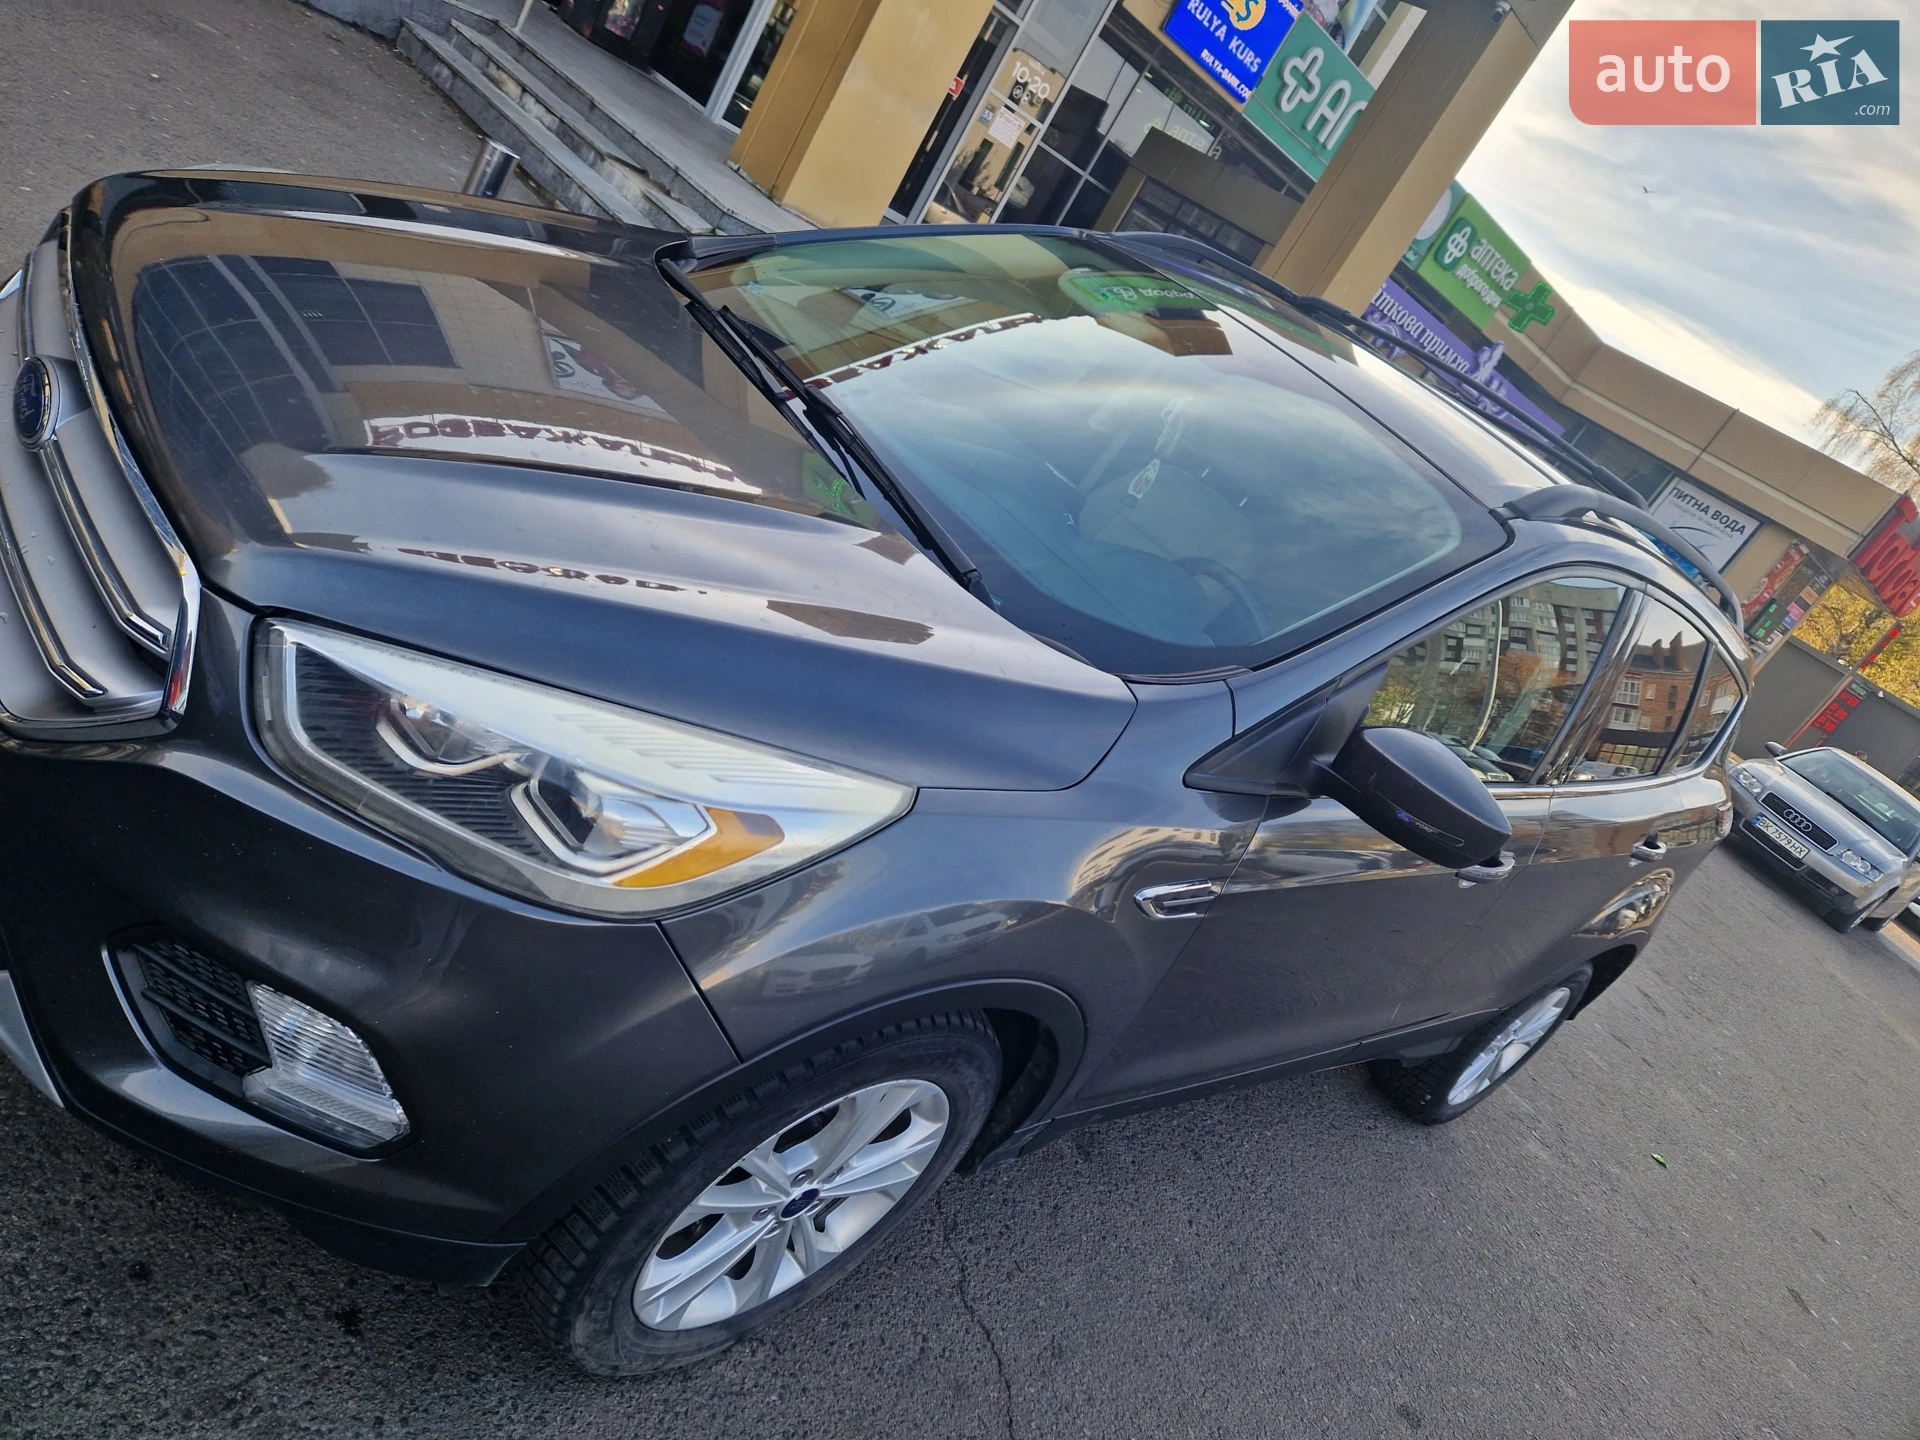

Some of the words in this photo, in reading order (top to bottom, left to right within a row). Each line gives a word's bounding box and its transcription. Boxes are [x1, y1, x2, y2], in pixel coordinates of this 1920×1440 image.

[1187, 0, 1228, 42] RULYA
[1228, 36, 1262, 73] KURS
[1470, 239, 1519, 292] аптека
[1667, 486, 1711, 516] ПИТНА
[1710, 509, 1746, 536] ВОДА
[1415, 821, 1434, 834] FORD
[1758, 818, 1772, 834] BK
[1770, 825, 1793, 850] 7579
[1790, 842, 1806, 857] HX
